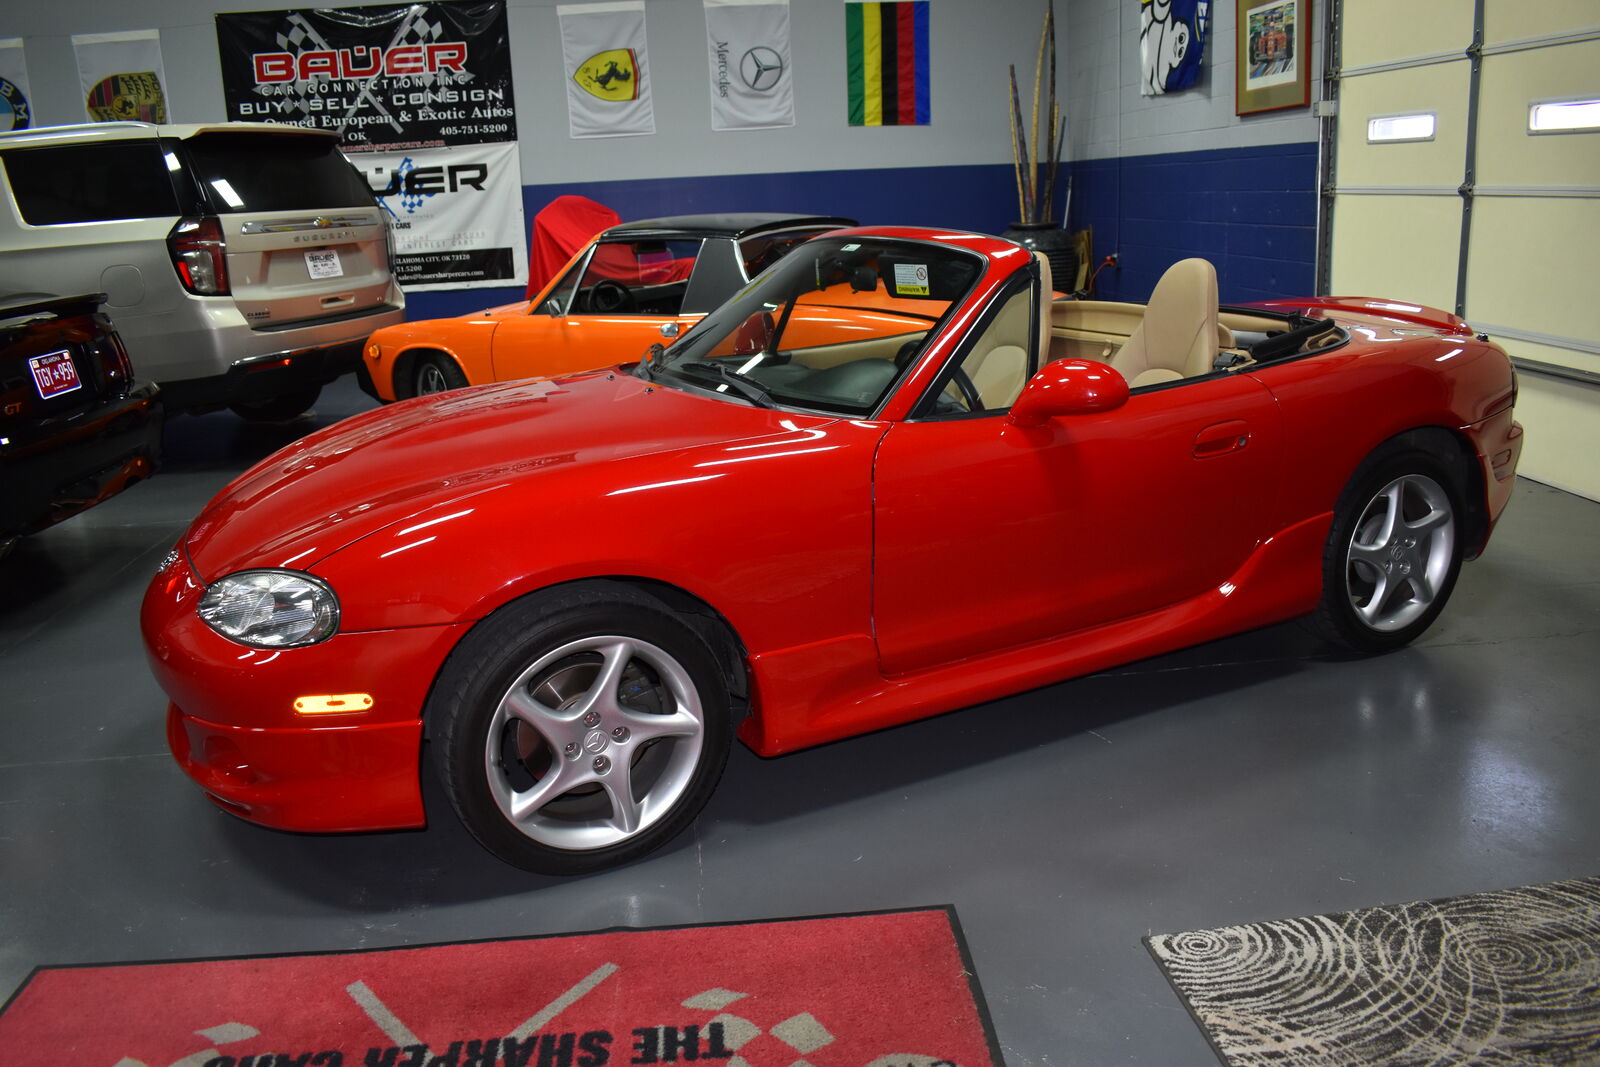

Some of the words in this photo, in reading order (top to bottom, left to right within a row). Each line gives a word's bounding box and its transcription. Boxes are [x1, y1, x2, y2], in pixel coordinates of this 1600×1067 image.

[716, 41, 730, 98] Mercedes
[261, 86, 295, 96] CAR
[307, 77, 424, 94] CONNECTION
[436, 74, 474, 87] INC.
[239, 101, 287, 115] BUY
[309, 97, 369, 112] SELL
[392, 88, 504, 106] CONSIGN
[321, 109, 393, 128] European
[398, 109, 412, 122] &
[417, 105, 466, 121] Exotic
[470, 105, 514, 120] Autos
[347, 131, 368, 142] OK
[438, 122, 508, 136] 405-751-5200
[395, 222, 411, 230] CARS
[441, 254, 451, 262] OK
[36, 367, 54, 387] TGY
[58, 362, 75, 380] 959
[5, 402, 22, 415] GT
[632, 1022, 735, 1065] THE
